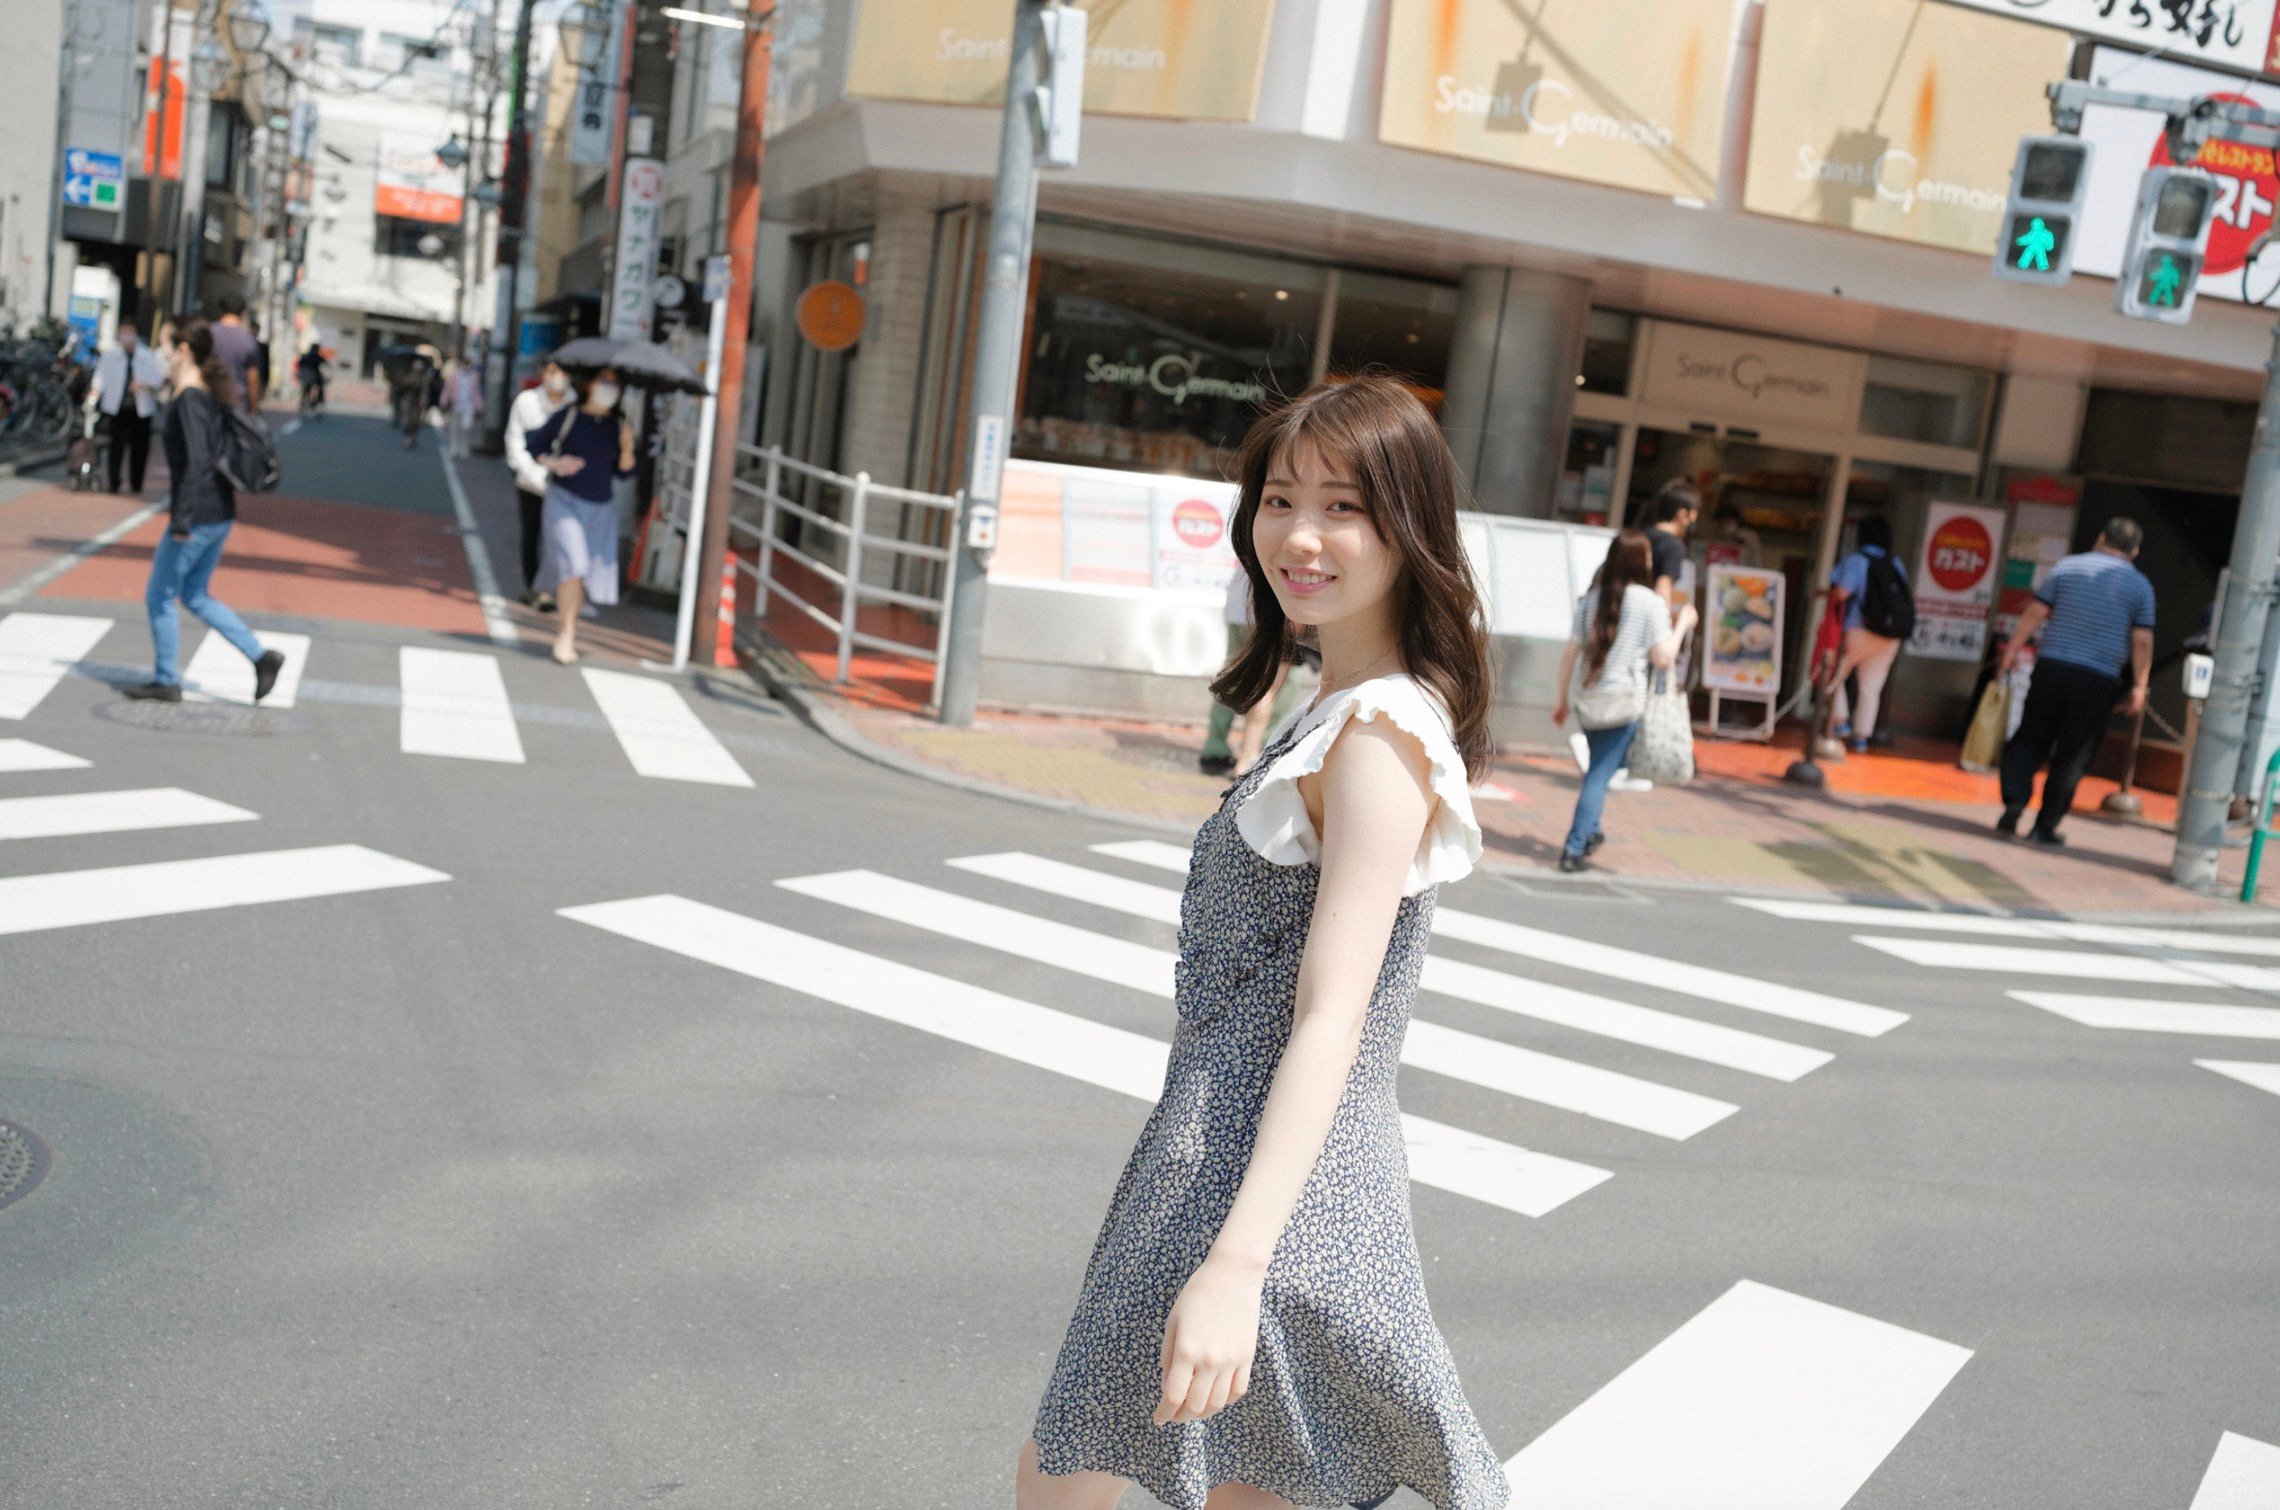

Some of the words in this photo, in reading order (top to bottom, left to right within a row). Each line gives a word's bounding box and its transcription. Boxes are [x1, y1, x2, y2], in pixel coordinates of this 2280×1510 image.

[2093, 0, 2244, 47] ら好し
[2172, 166, 2274, 230] スト
[1933, 547, 1986, 574] ガスト
